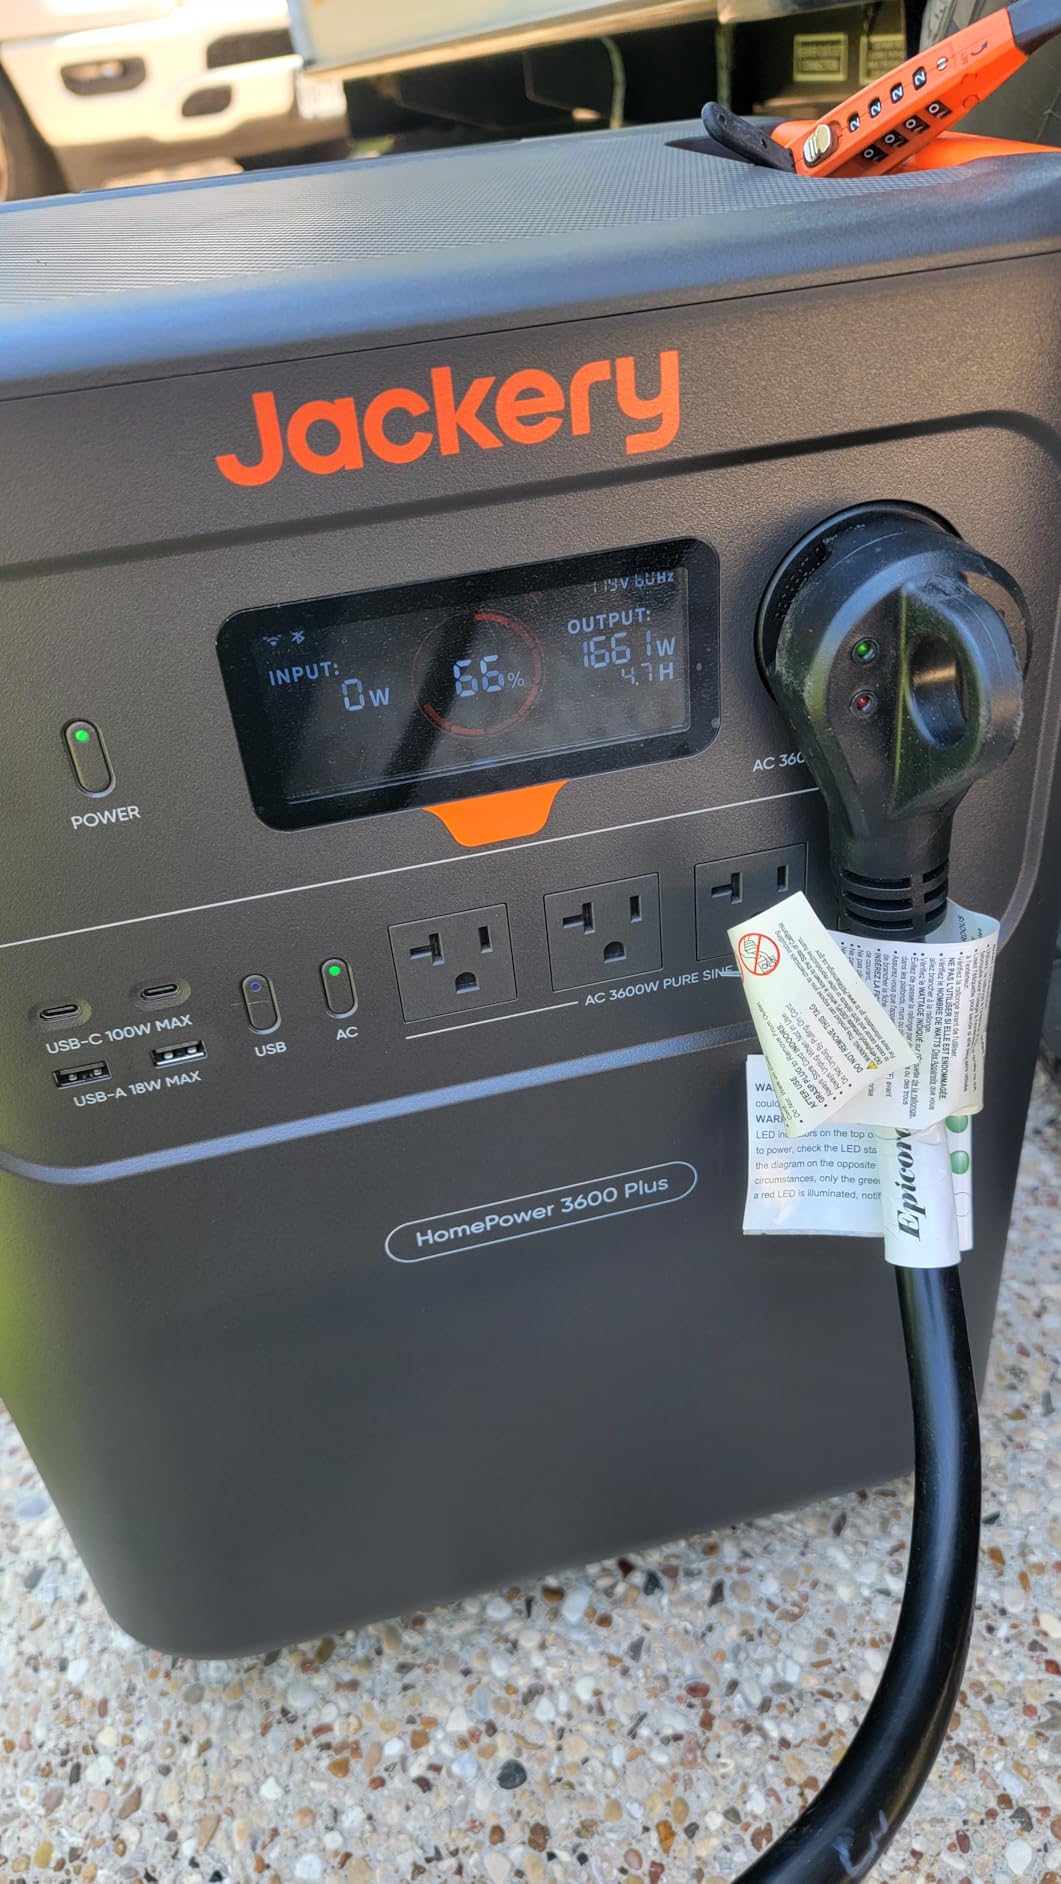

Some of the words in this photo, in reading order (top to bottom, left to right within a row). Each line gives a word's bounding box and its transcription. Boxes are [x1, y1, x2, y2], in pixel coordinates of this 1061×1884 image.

[215, 350, 680, 486] Jackery
[567, 607, 651, 635] OUTPUT:
[268, 661, 340, 686] INPUT:
[752, 757, 775, 772] AC
[70, 806, 141, 830] POWER
[947, 957, 954, 966] NE
[585, 992, 605, 1006] AC
[610, 980, 662, 1001] 3600W
[663, 972, 699, 989] PURE
[808, 1002, 821, 1017] TAG
[916, 986, 925, 1016] WATTAGE
[935, 987, 944, 1015] NOMBRE
[817, 1014, 831, 1030] THIS
[934, 1016, 942, 1025] DE
[46, 1034, 102, 1054] USB-C
[106, 1022, 150, 1042] 100W
[156, 1014, 193, 1032] MAX
[336, 1026, 358, 1040] AC
[826, 1027, 848, 1053] REMOVE
[933, 1026, 941, 1047] WATTS
[254, 1042, 287, 1056] USB
[844, 1050, 856, 1065] NOT
[794, 1065, 810, 1084] PLUG
[852, 1062, 863, 1073] DO
[74, 1087, 128, 1107] USB-A
[128, 1080, 161, 1096] 18W
[164, 1070, 202, 1087] MAX
[789, 1074, 802, 1090] USE
[798, 1087, 817, 1109] AFTER
[806, 1081, 825, 1103] GRASP
[834, 1128, 847, 1137] the
[851, 1129, 864, 1140] top
[767, 1146, 794, 1156] power,
[797, 1144, 821, 1153] check
[841, 1145, 860, 1153] LED
[837, 1161, 876, 1170] opposite
[755, 1175, 816, 1184] circumstances,
[820, 1175, 838, 1184] only
[841, 1175, 855, 1184] the
[808, 1189, 858, 1200] illuminated,
[862, 1192, 882, 1200] notif
[416, 1205, 554, 1246] HomePower
[560, 1187, 618, 1213] 3600
[624, 1177, 669, 1199] Plus
